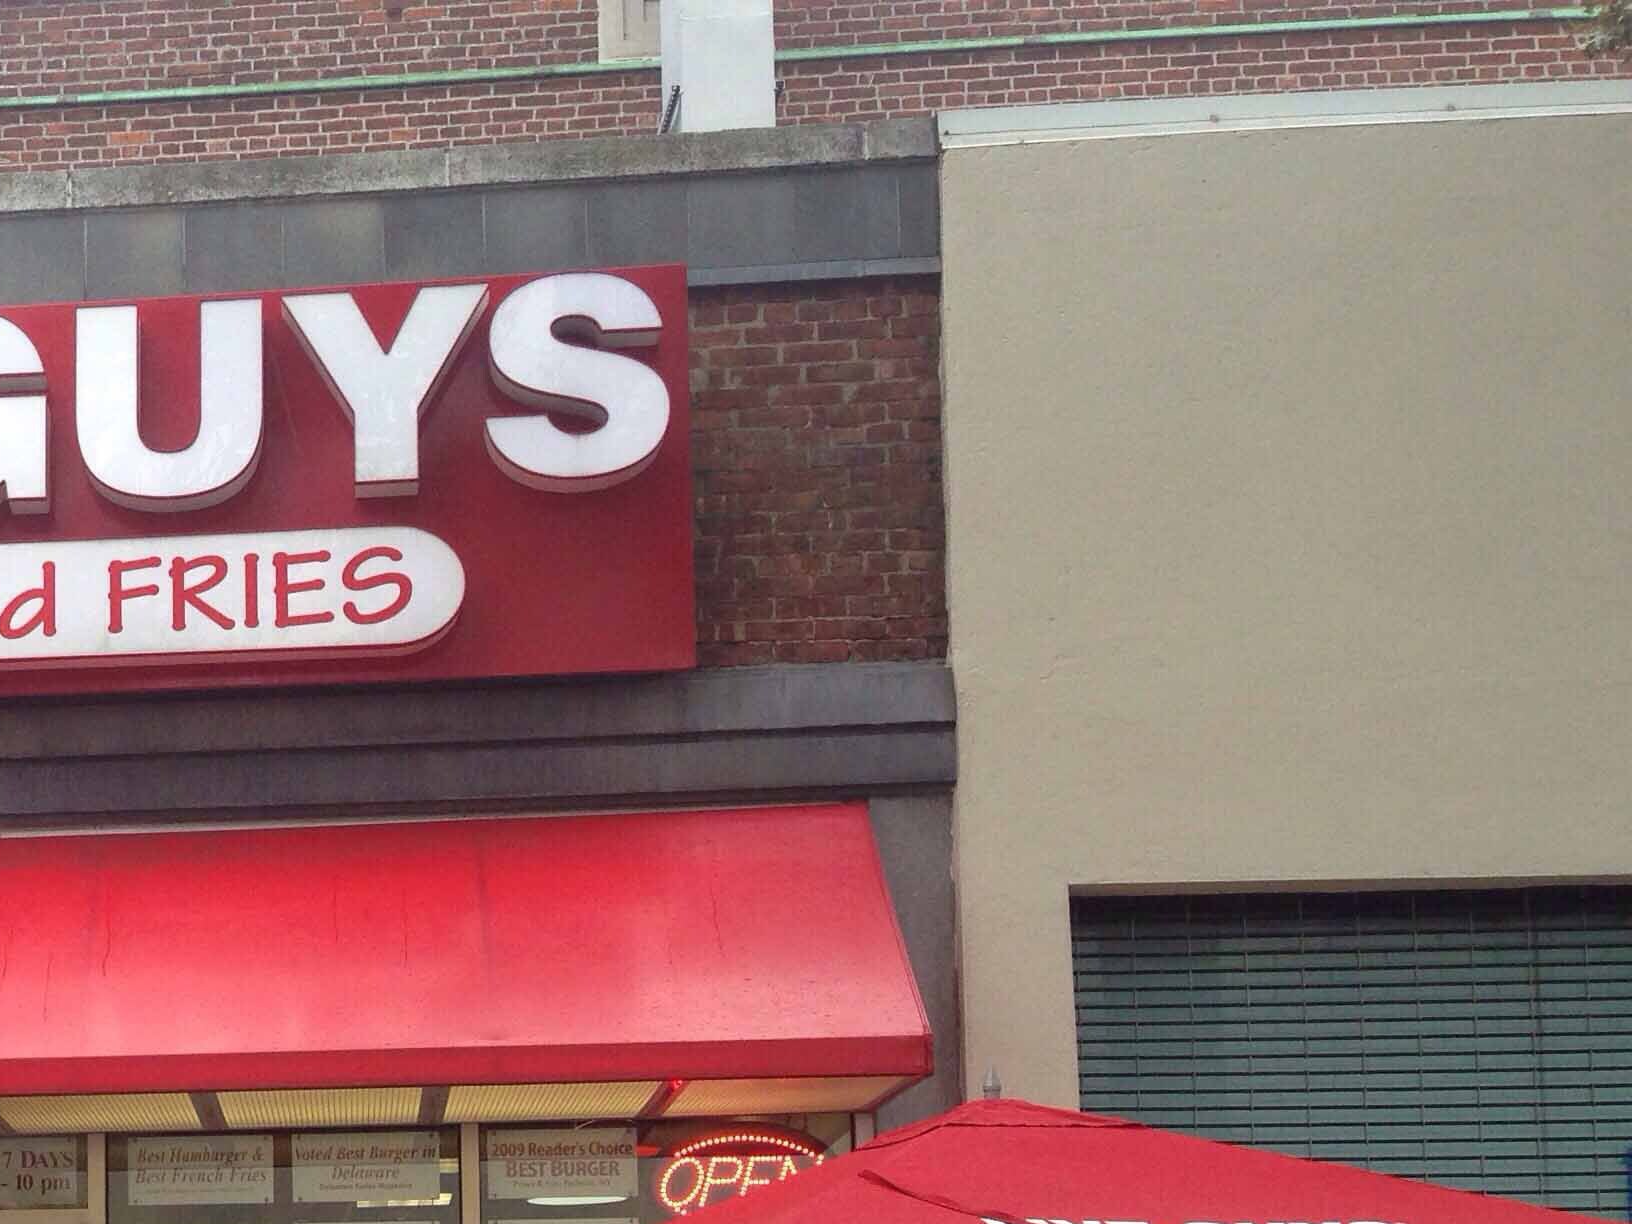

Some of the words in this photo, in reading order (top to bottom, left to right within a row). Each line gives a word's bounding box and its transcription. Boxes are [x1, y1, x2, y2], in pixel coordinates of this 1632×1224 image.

[107, 546, 414, 635] FRIES
[137, 1148, 165, 1163] Best
[168, 1146, 248, 1167] Hamburger
[252, 1146, 265, 1162] &
[295, 1145, 333, 1161] Voted
[336, 1146, 365, 1160] Best
[369, 1145, 418, 1163] Burger
[494, 1142, 524, 1157] 2009
[527, 1142, 585, 1156] Reader's
[589, 1141, 633, 1156] Choice
[1, 1151, 13, 1169] 7
[21, 1151, 75, 1169] DAYS
[506, 1161, 548, 1178] BEST
[550, 1160, 621, 1177] BURGER
[135, 1168, 167, 1184] Best
[171, 1167, 224, 1184] French
[230, 1166, 267, 1183] Fries
[331, 1164, 401, 1181] Delaware
[17, 1174, 34, 1191] 10
[41, 1176, 72, 1195] pm
